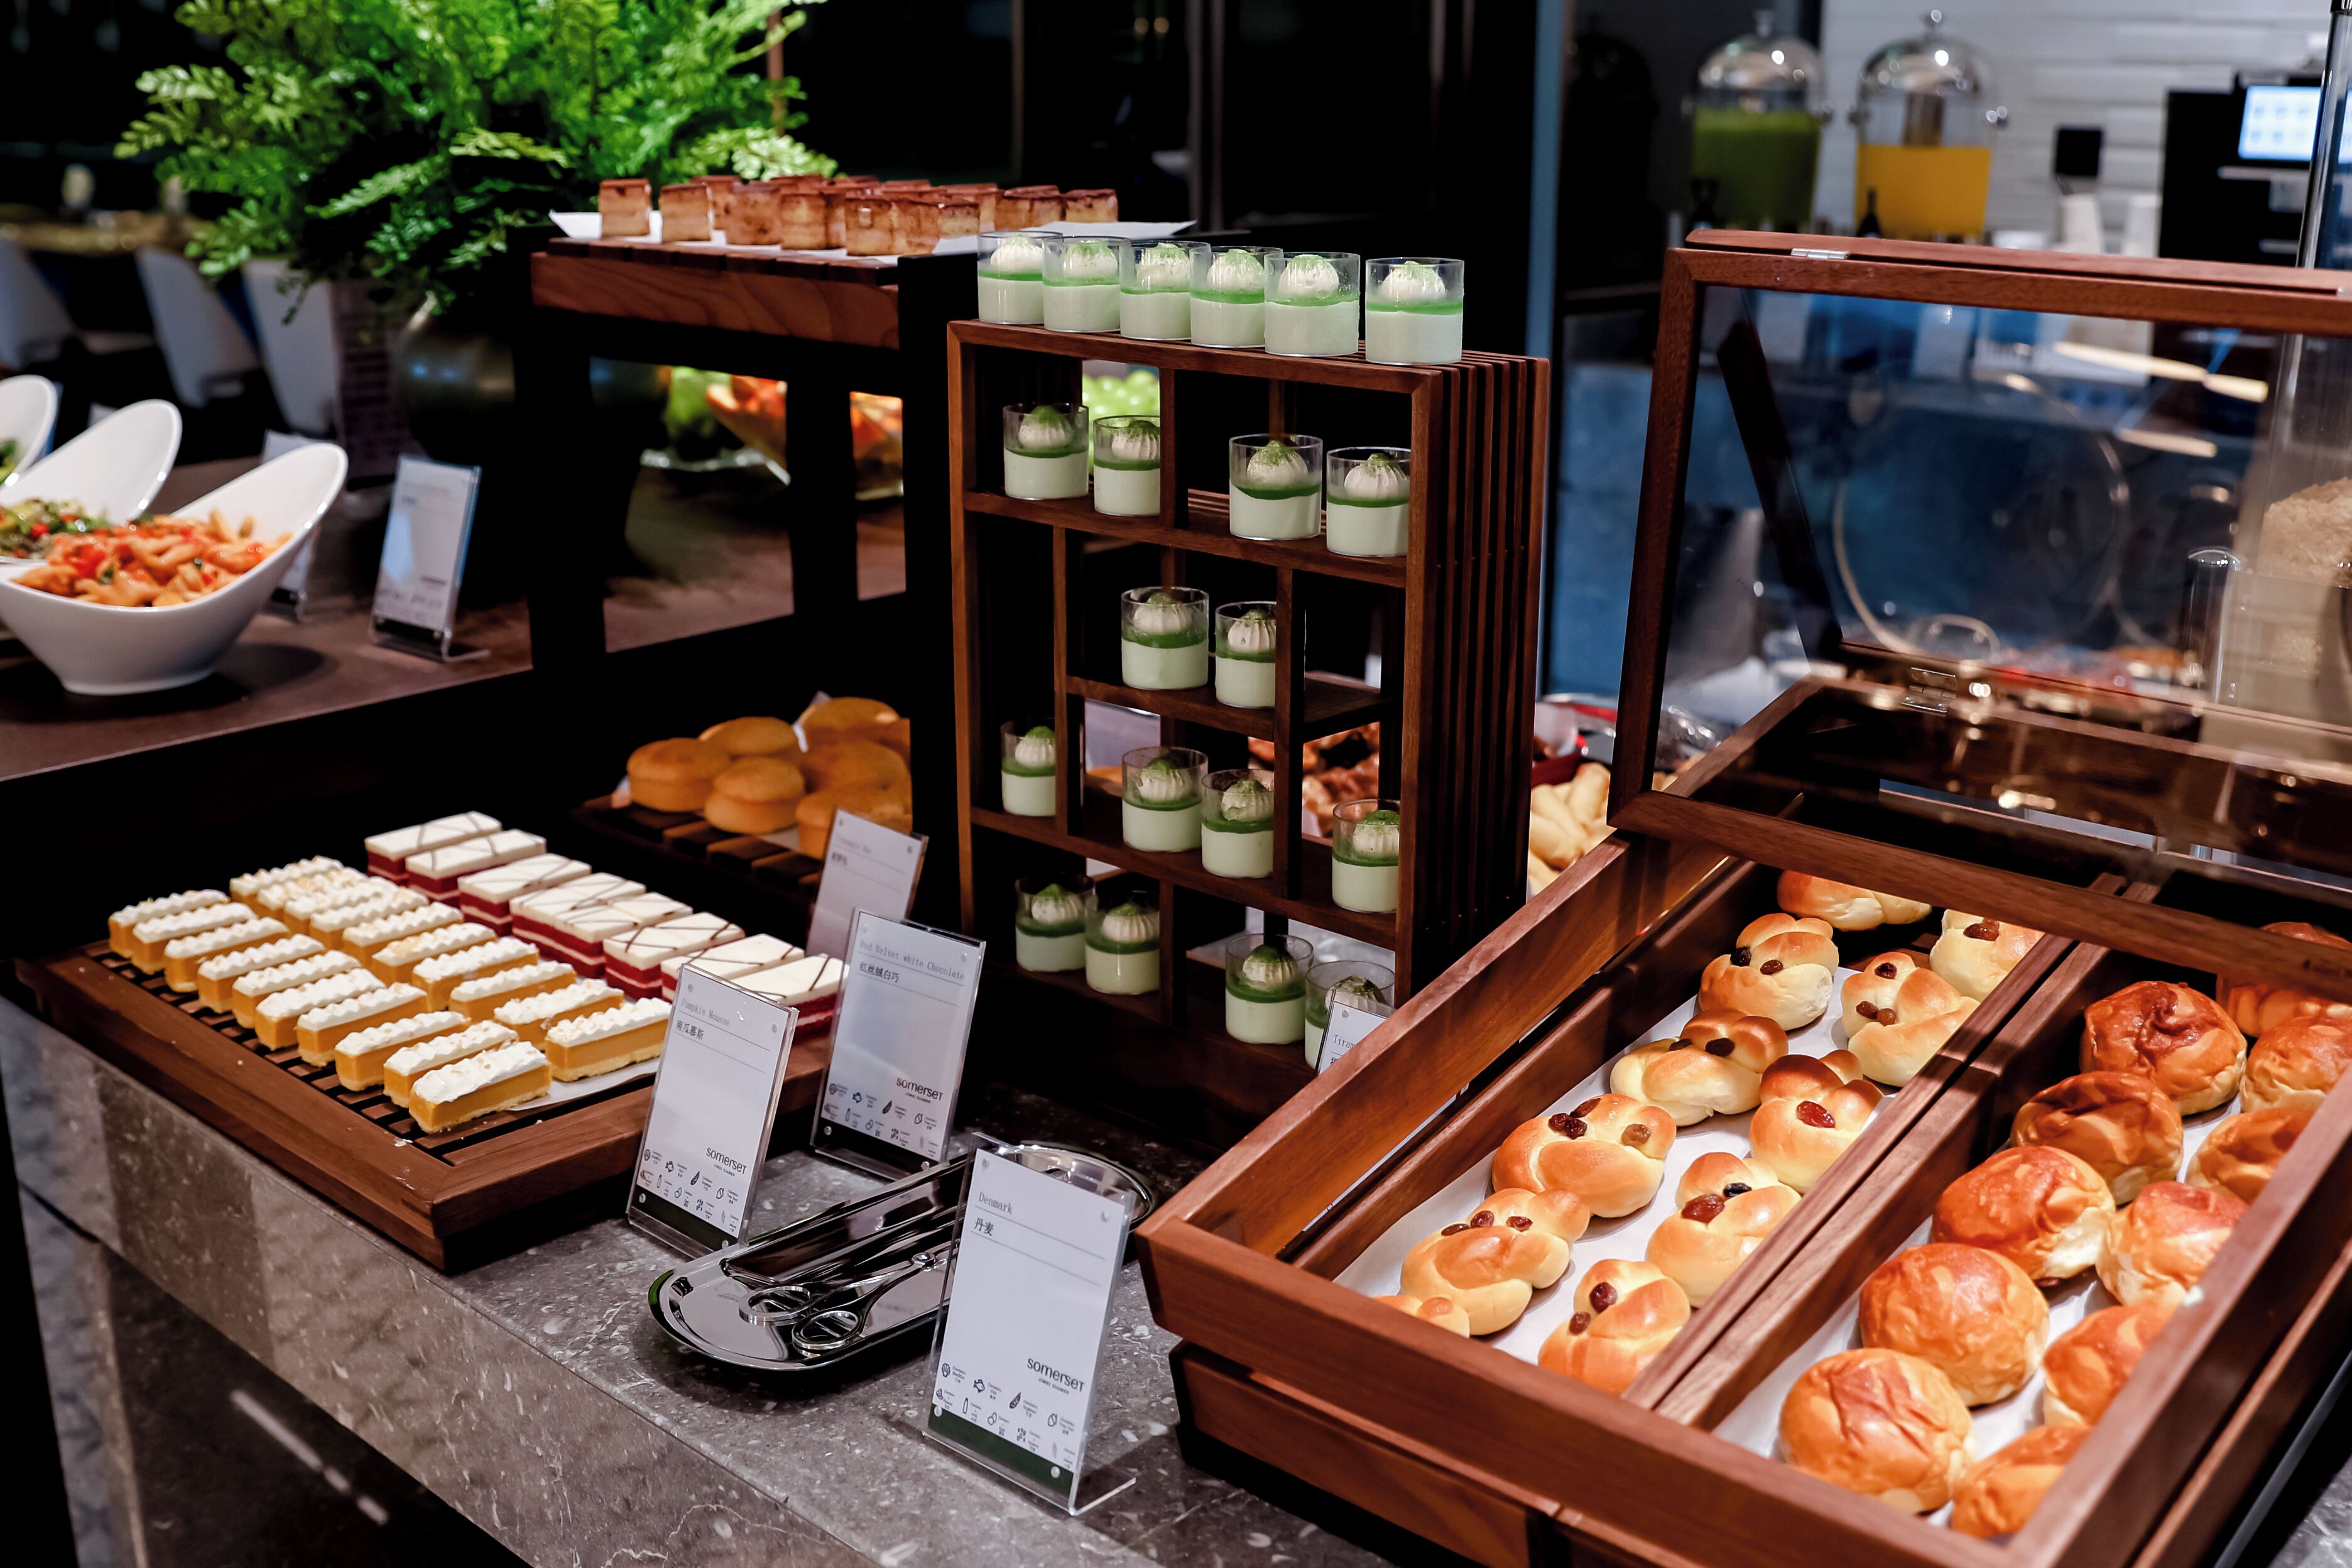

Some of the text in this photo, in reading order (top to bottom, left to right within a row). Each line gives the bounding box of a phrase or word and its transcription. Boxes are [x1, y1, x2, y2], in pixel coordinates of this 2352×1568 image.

[876, 944, 898, 960] Velvet
[927, 961, 965, 981] Chocolate
[708, 1010, 730, 1026] Mousse
[978, 1191, 1013, 1214] Denmark
[974, 1217, 994, 1237] 丹麦
